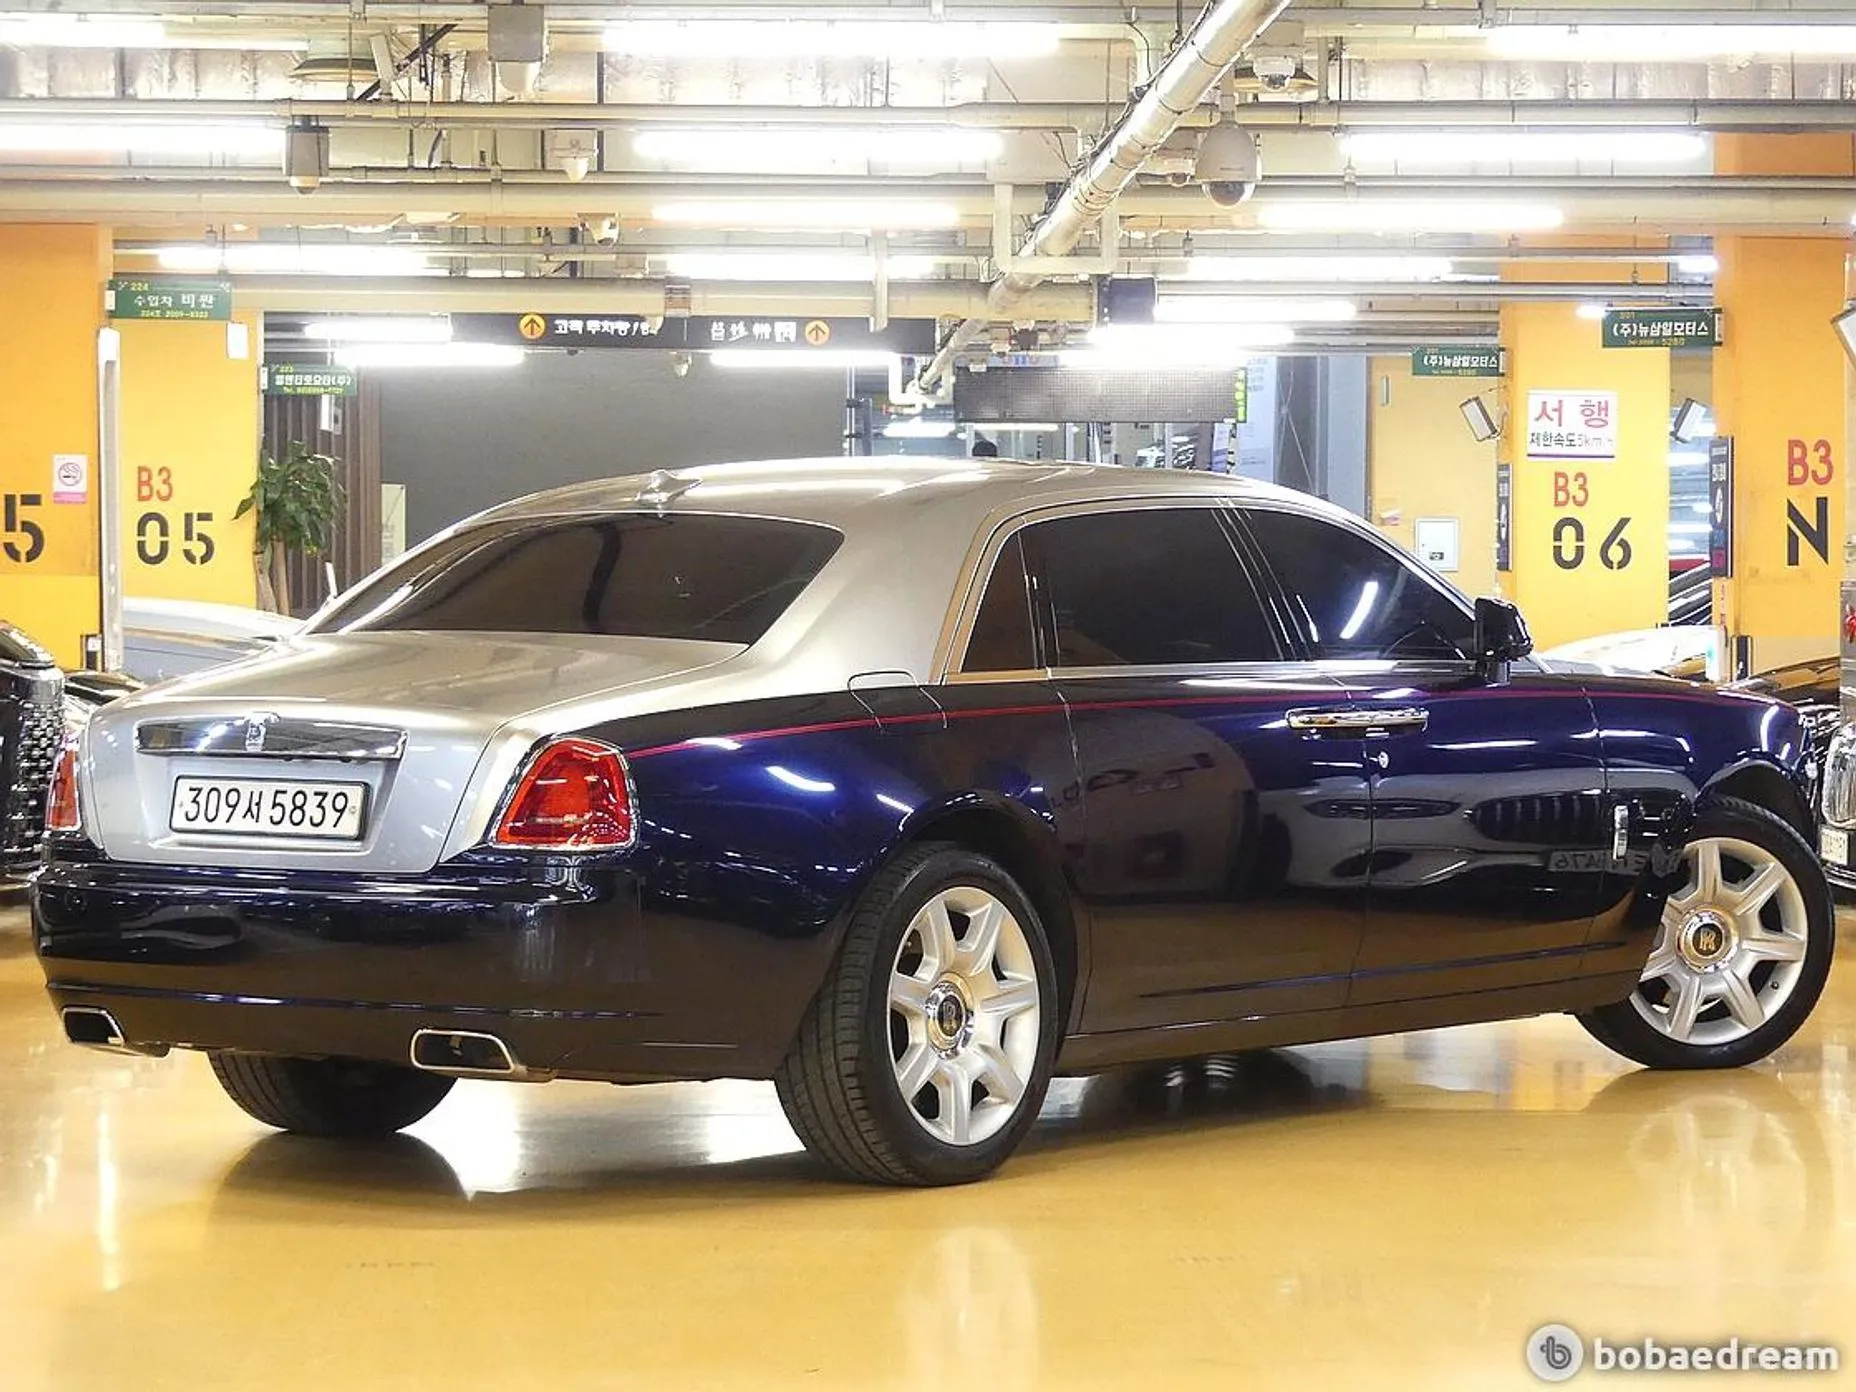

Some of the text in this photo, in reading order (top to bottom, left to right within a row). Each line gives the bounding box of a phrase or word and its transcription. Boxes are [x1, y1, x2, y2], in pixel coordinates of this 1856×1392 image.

[134, 294, 173, 307] 수입차
[137, 465, 174, 502] B3
[1788, 439, 1834, 486] B3
[1553, 471, 1589, 507] B3
[3, 493, 45, 563] 5
[136, 511, 215, 566] 05
[1552, 516, 1632, 570] 06
[1786, 496, 1829, 567] N
